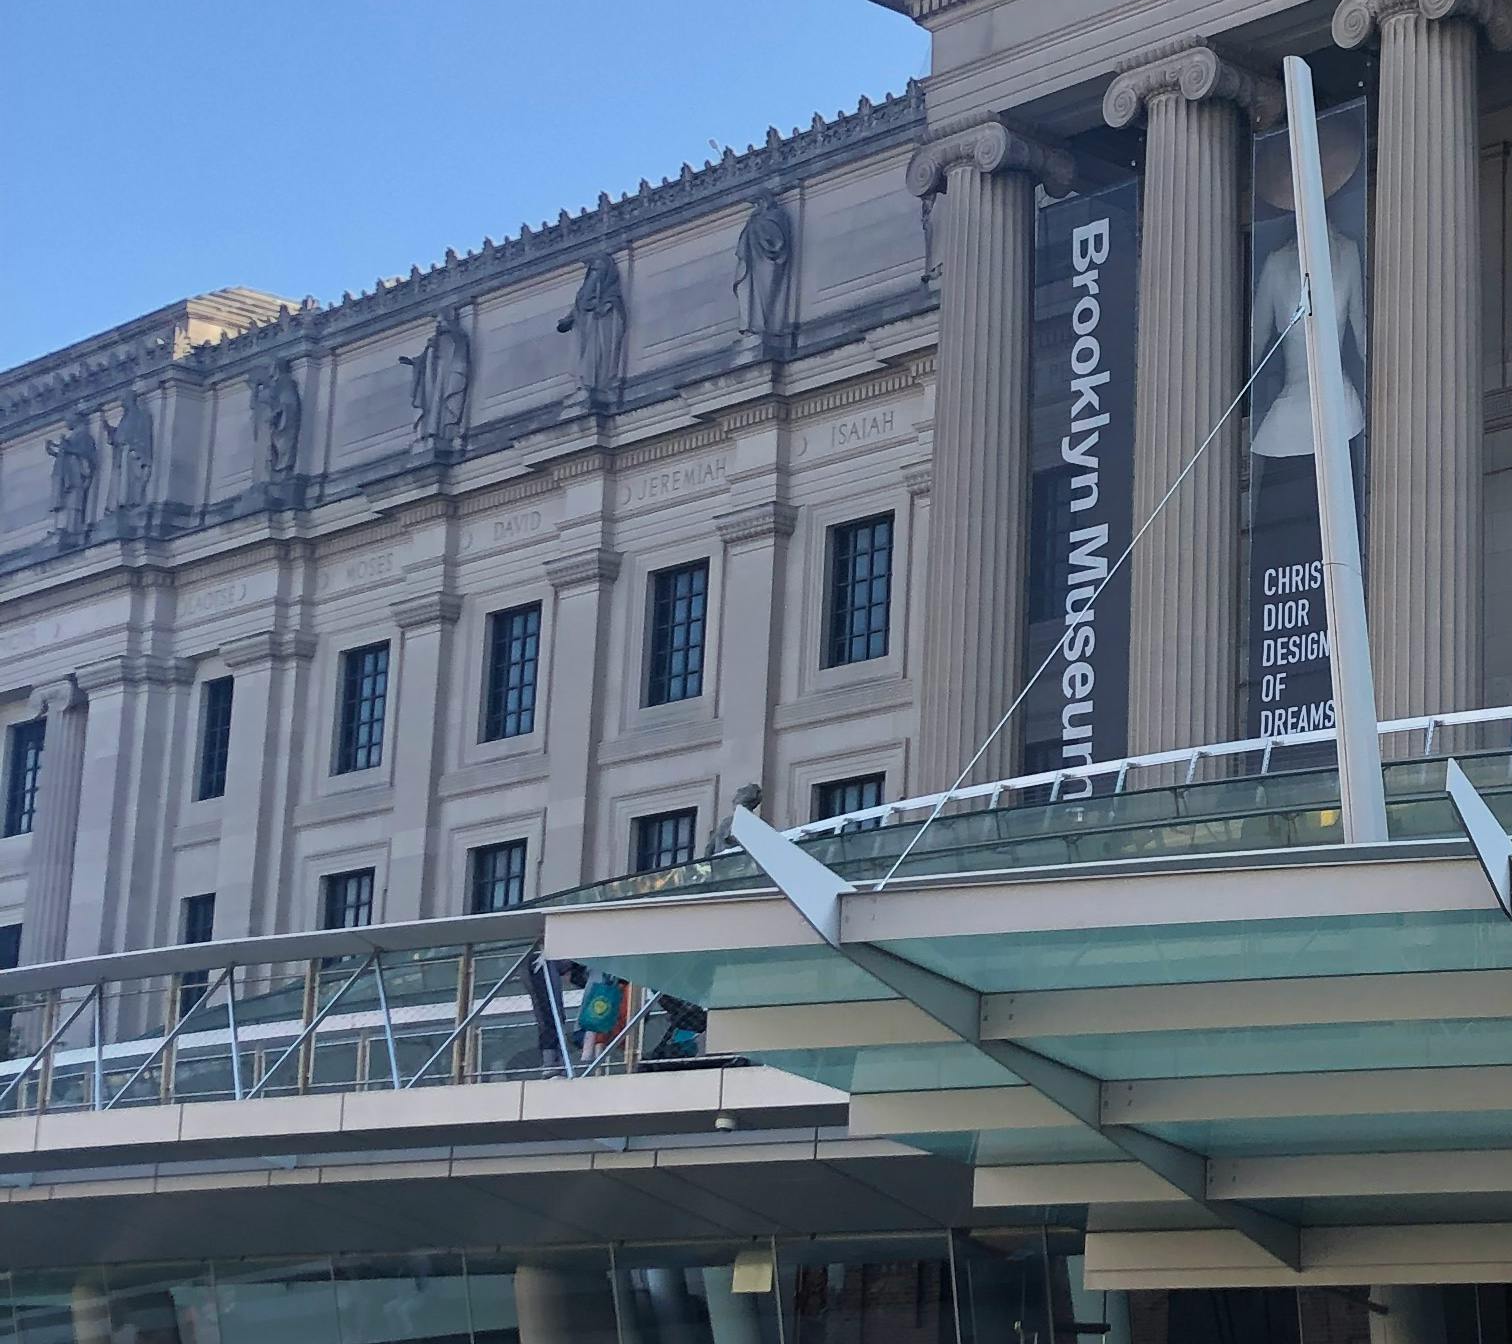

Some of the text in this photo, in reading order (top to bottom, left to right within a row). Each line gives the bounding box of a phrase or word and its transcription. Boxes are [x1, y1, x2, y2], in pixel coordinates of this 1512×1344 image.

[831, 410, 894, 449] ISAIAH
[638, 457, 727, 502] JEREMIAH
[1061, 217, 1110, 801] Brooklyn Museum
[1263, 560, 1324, 596] CHRIS
[1263, 598, 1310, 632] DIOR
[1261, 672, 1287, 703] OF
[1260, 699, 1336, 738] DREAMS
